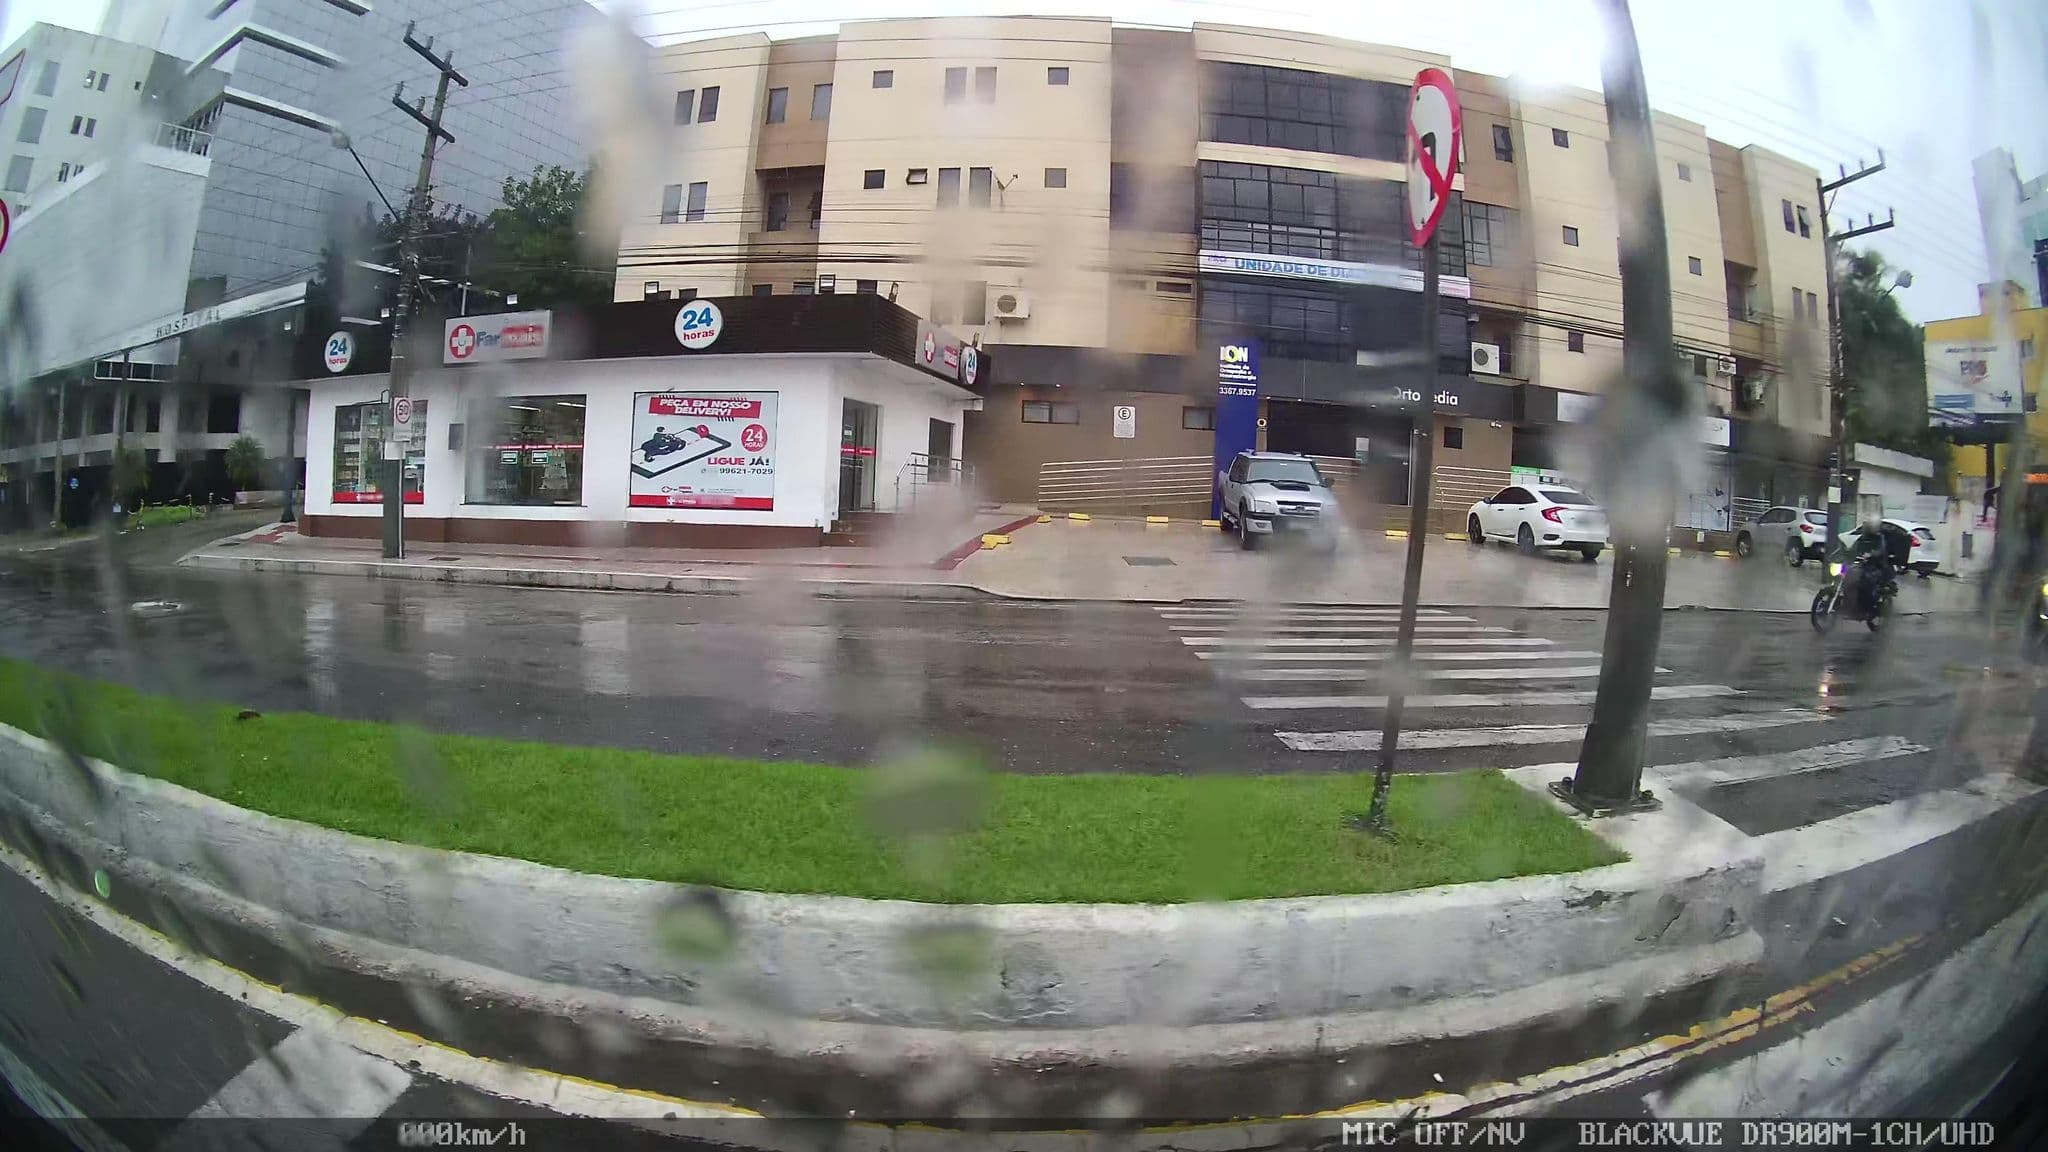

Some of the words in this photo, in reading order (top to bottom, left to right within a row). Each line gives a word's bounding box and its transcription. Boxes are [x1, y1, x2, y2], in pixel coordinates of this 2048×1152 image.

[1234, 257, 1304, 275] UNIDADE
[1307, 264, 1328, 277] DE
[683, 307, 714, 330] 24
[683, 330, 715, 340] horas
[330, 338, 348, 356] 24
[1220, 345, 1249, 362] ION
[328, 357, 348, 365] horas
[1219, 387, 1257, 396] 3367.9537
[1393, 386, 1458, 405] Ortodia
[398, 404, 409, 416] 50
[692, 400, 709, 408] EM
[711, 401, 752, 409] NOSSO
[674, 407, 732, 416] DELIVERY!
[745, 429, 764, 442] 24
[707, 457, 745, 465] LIGUE
[749, 456, 770, 466] JÁ!
[719, 467, 774, 475] 99621-7029
